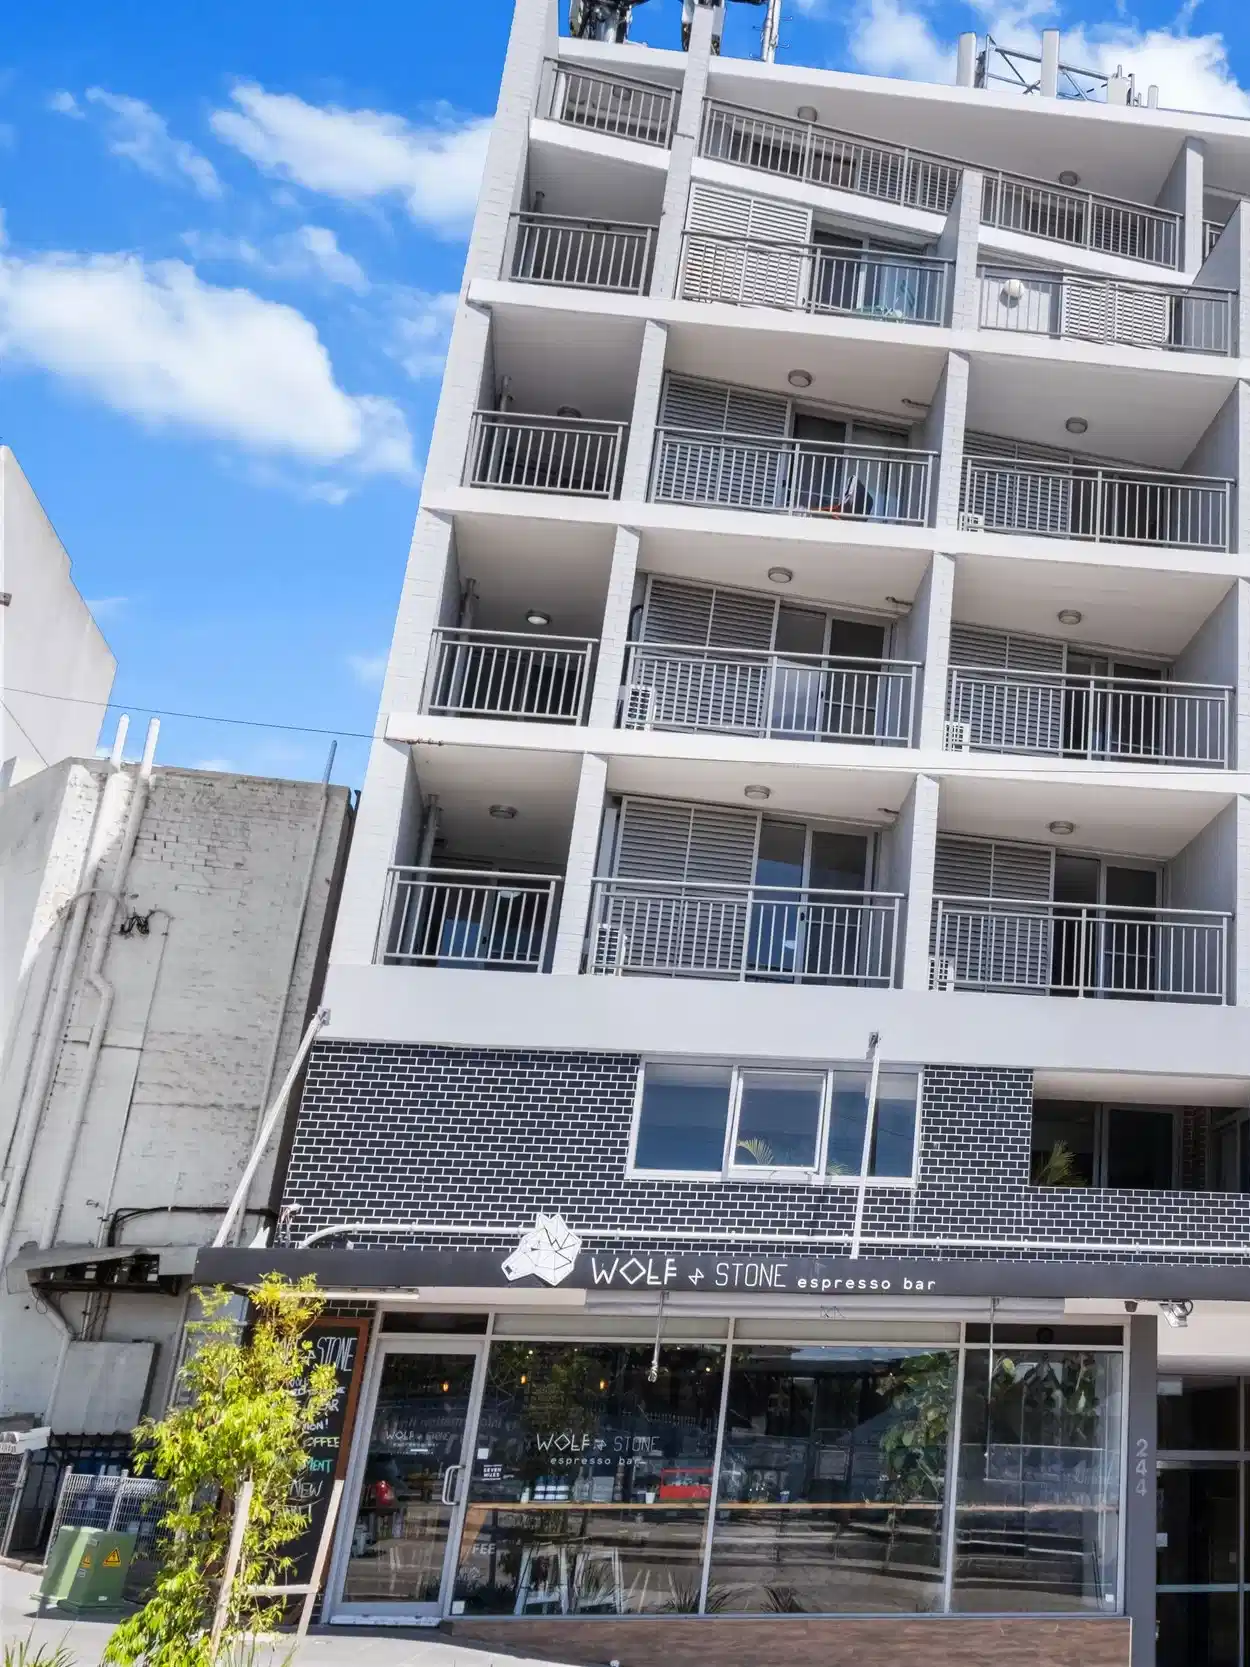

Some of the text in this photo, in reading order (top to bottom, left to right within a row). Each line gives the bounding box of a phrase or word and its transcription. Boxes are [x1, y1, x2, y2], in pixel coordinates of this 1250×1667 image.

[591, 1258, 677, 1285] WOLF
[716, 1263, 788, 1288] STONE
[797, 1278, 891, 1290] espresso
[903, 1277, 936, 1290] bar
[536, 1433, 590, 1451] WOLF
[614, 1436, 660, 1452] STONE
[551, 1456, 640, 1467] espresso bar
[1135, 1438, 1149, 1497] 244
